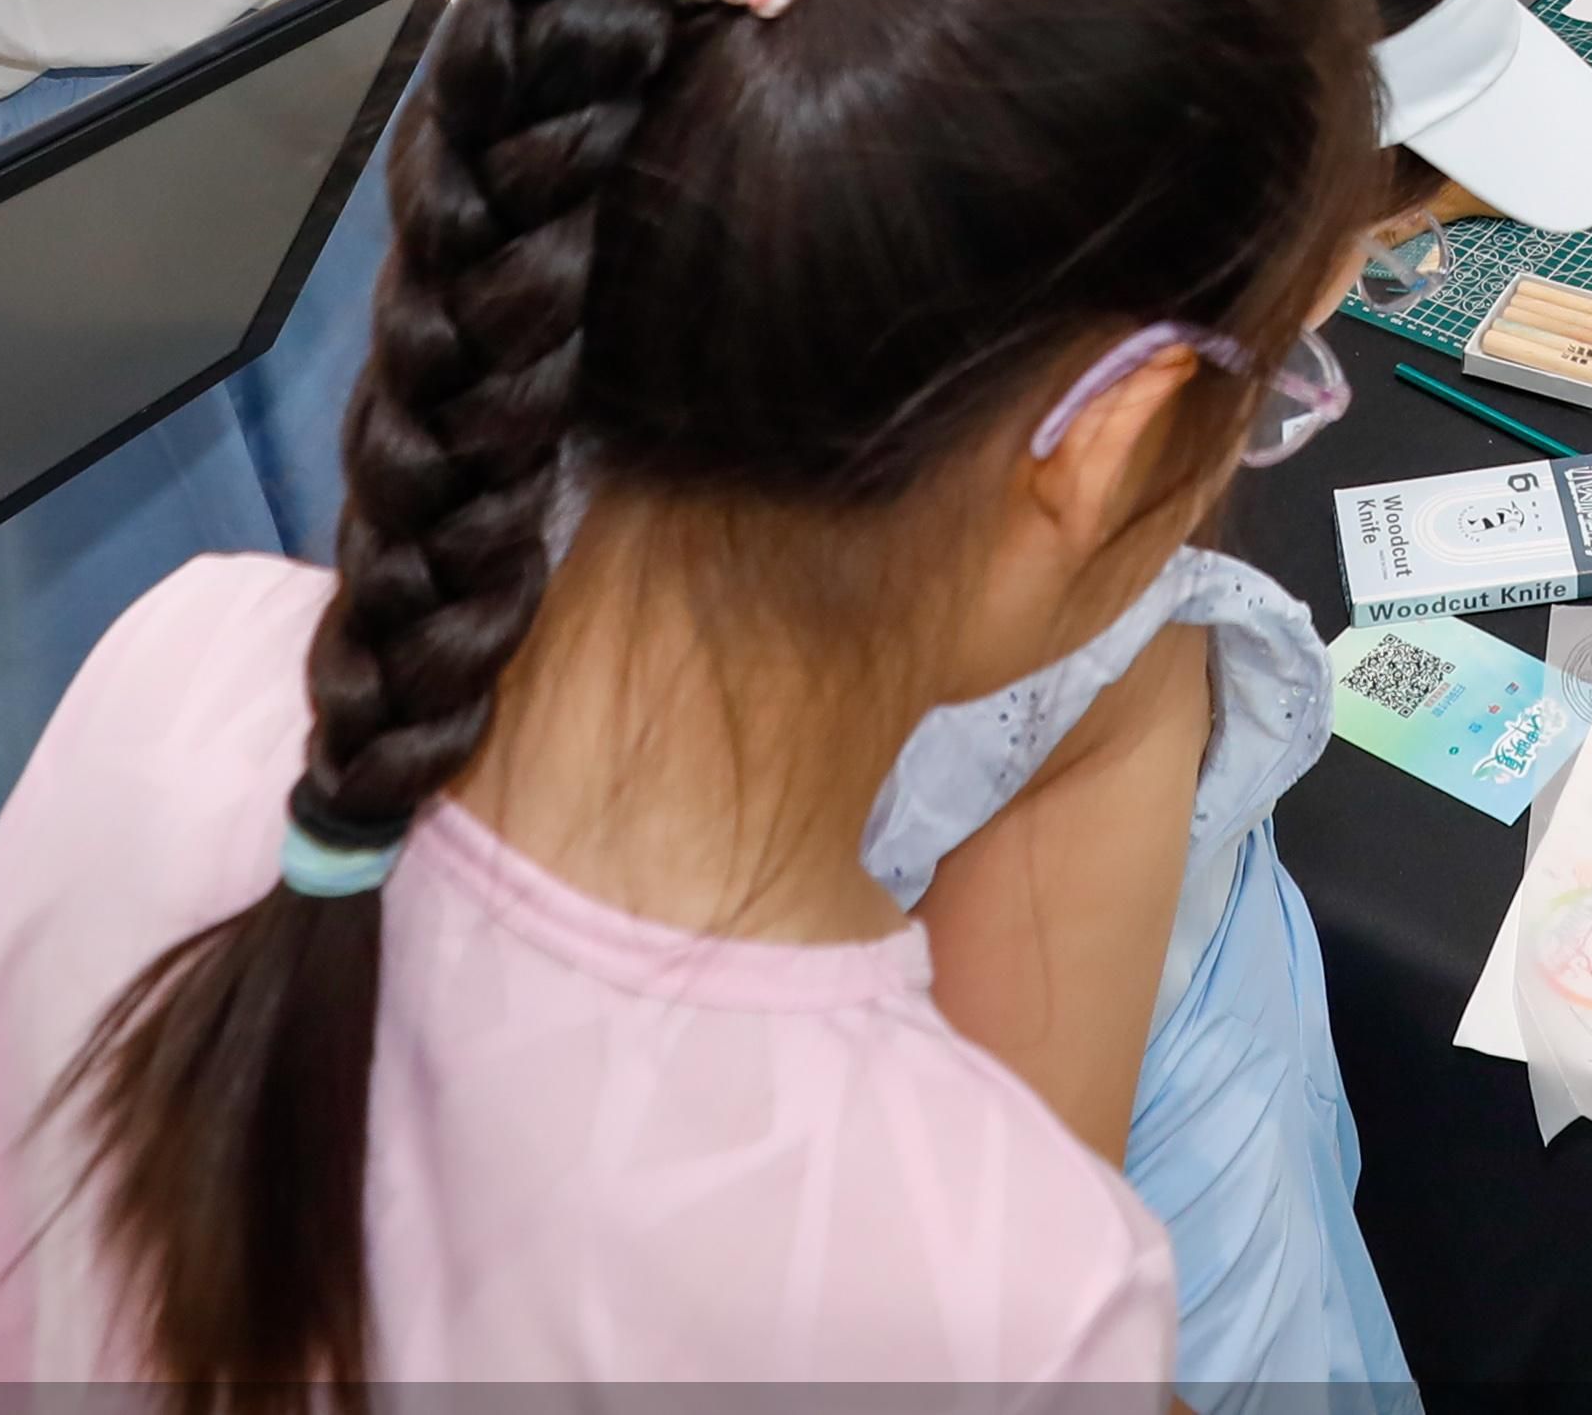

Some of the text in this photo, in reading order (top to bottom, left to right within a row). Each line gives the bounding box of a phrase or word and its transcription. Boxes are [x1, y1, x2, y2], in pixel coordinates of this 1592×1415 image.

[1507, 472, 1540, 493] 6
[1356, 499, 1378, 545] Knife
[1381, 493, 1413, 579] Woodcut
[1368, 581, 1567, 623] Woodcut Knife
